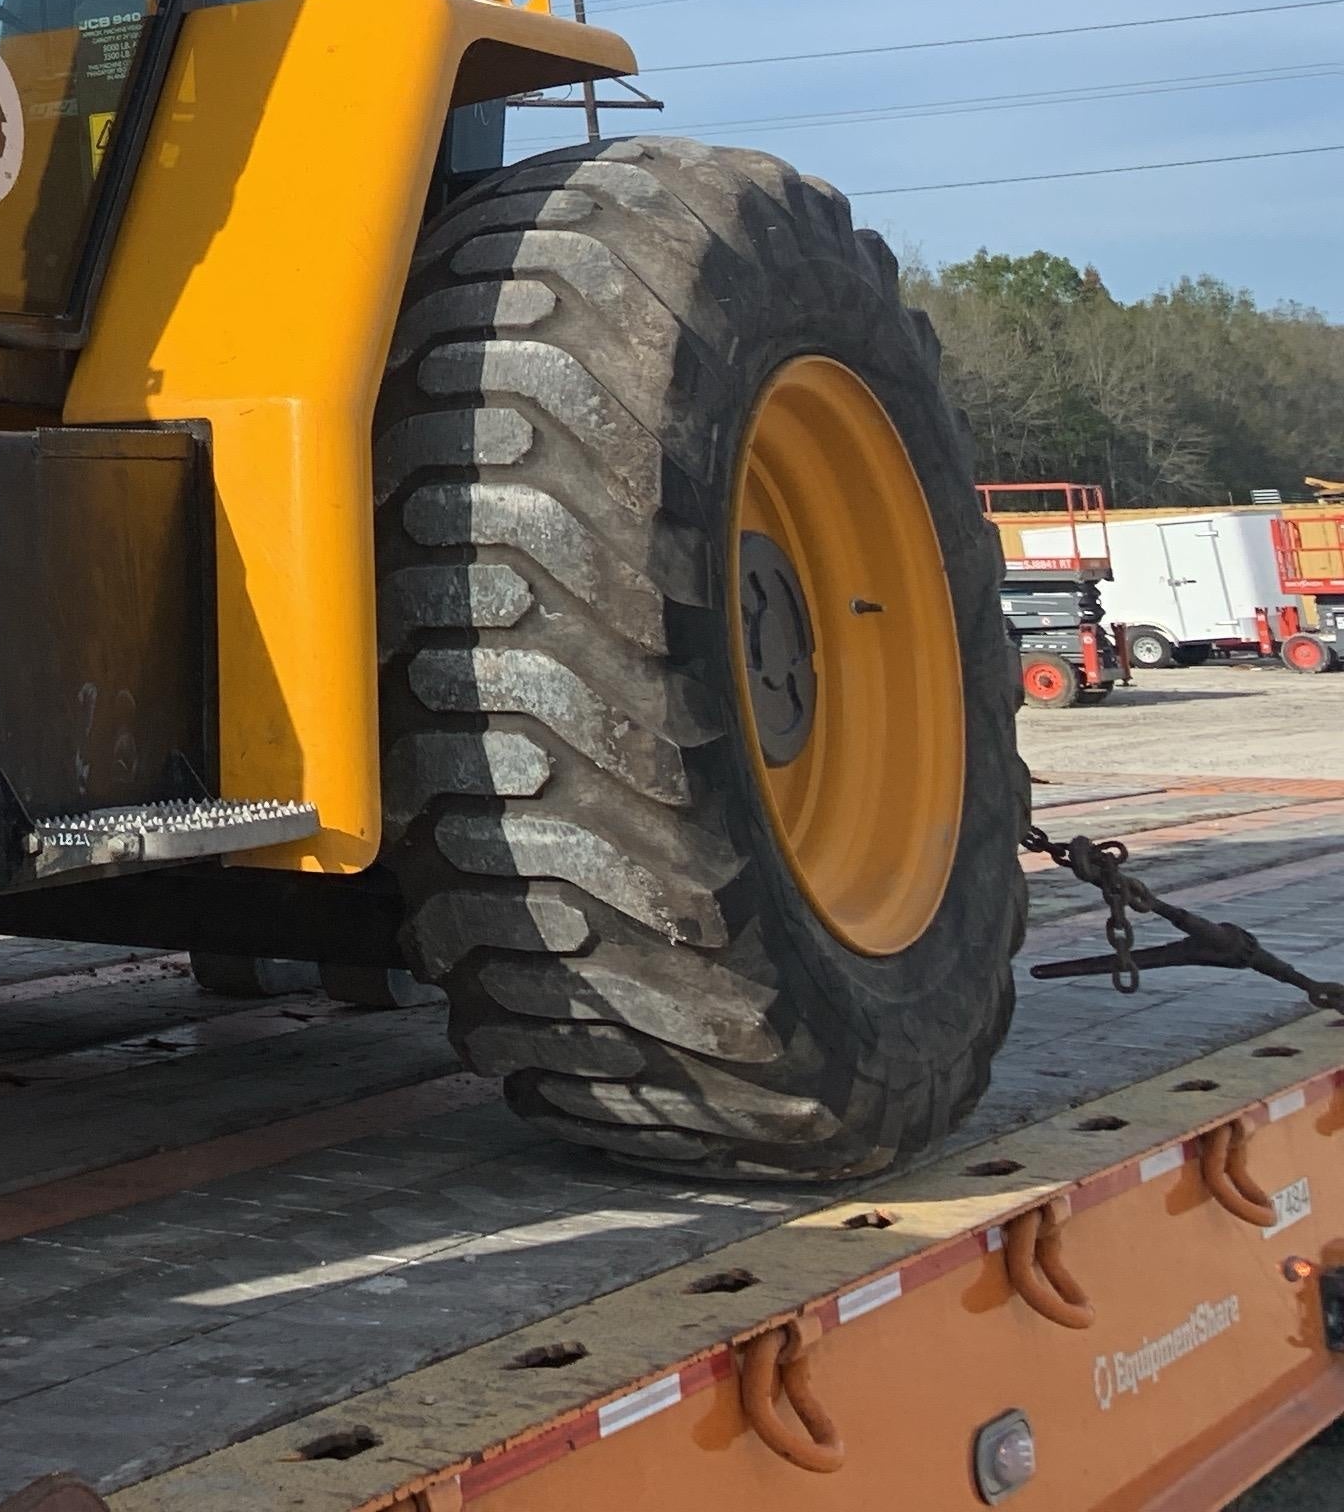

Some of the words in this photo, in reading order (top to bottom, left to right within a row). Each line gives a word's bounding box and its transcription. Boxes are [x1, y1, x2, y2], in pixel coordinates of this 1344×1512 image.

[79, 17, 111, 30] JCB
[112, 12, 141, 24] 940
[1273, 1180, 1309, 1225] 7484
[1113, 1294, 1240, 1394] EquipmentShare
